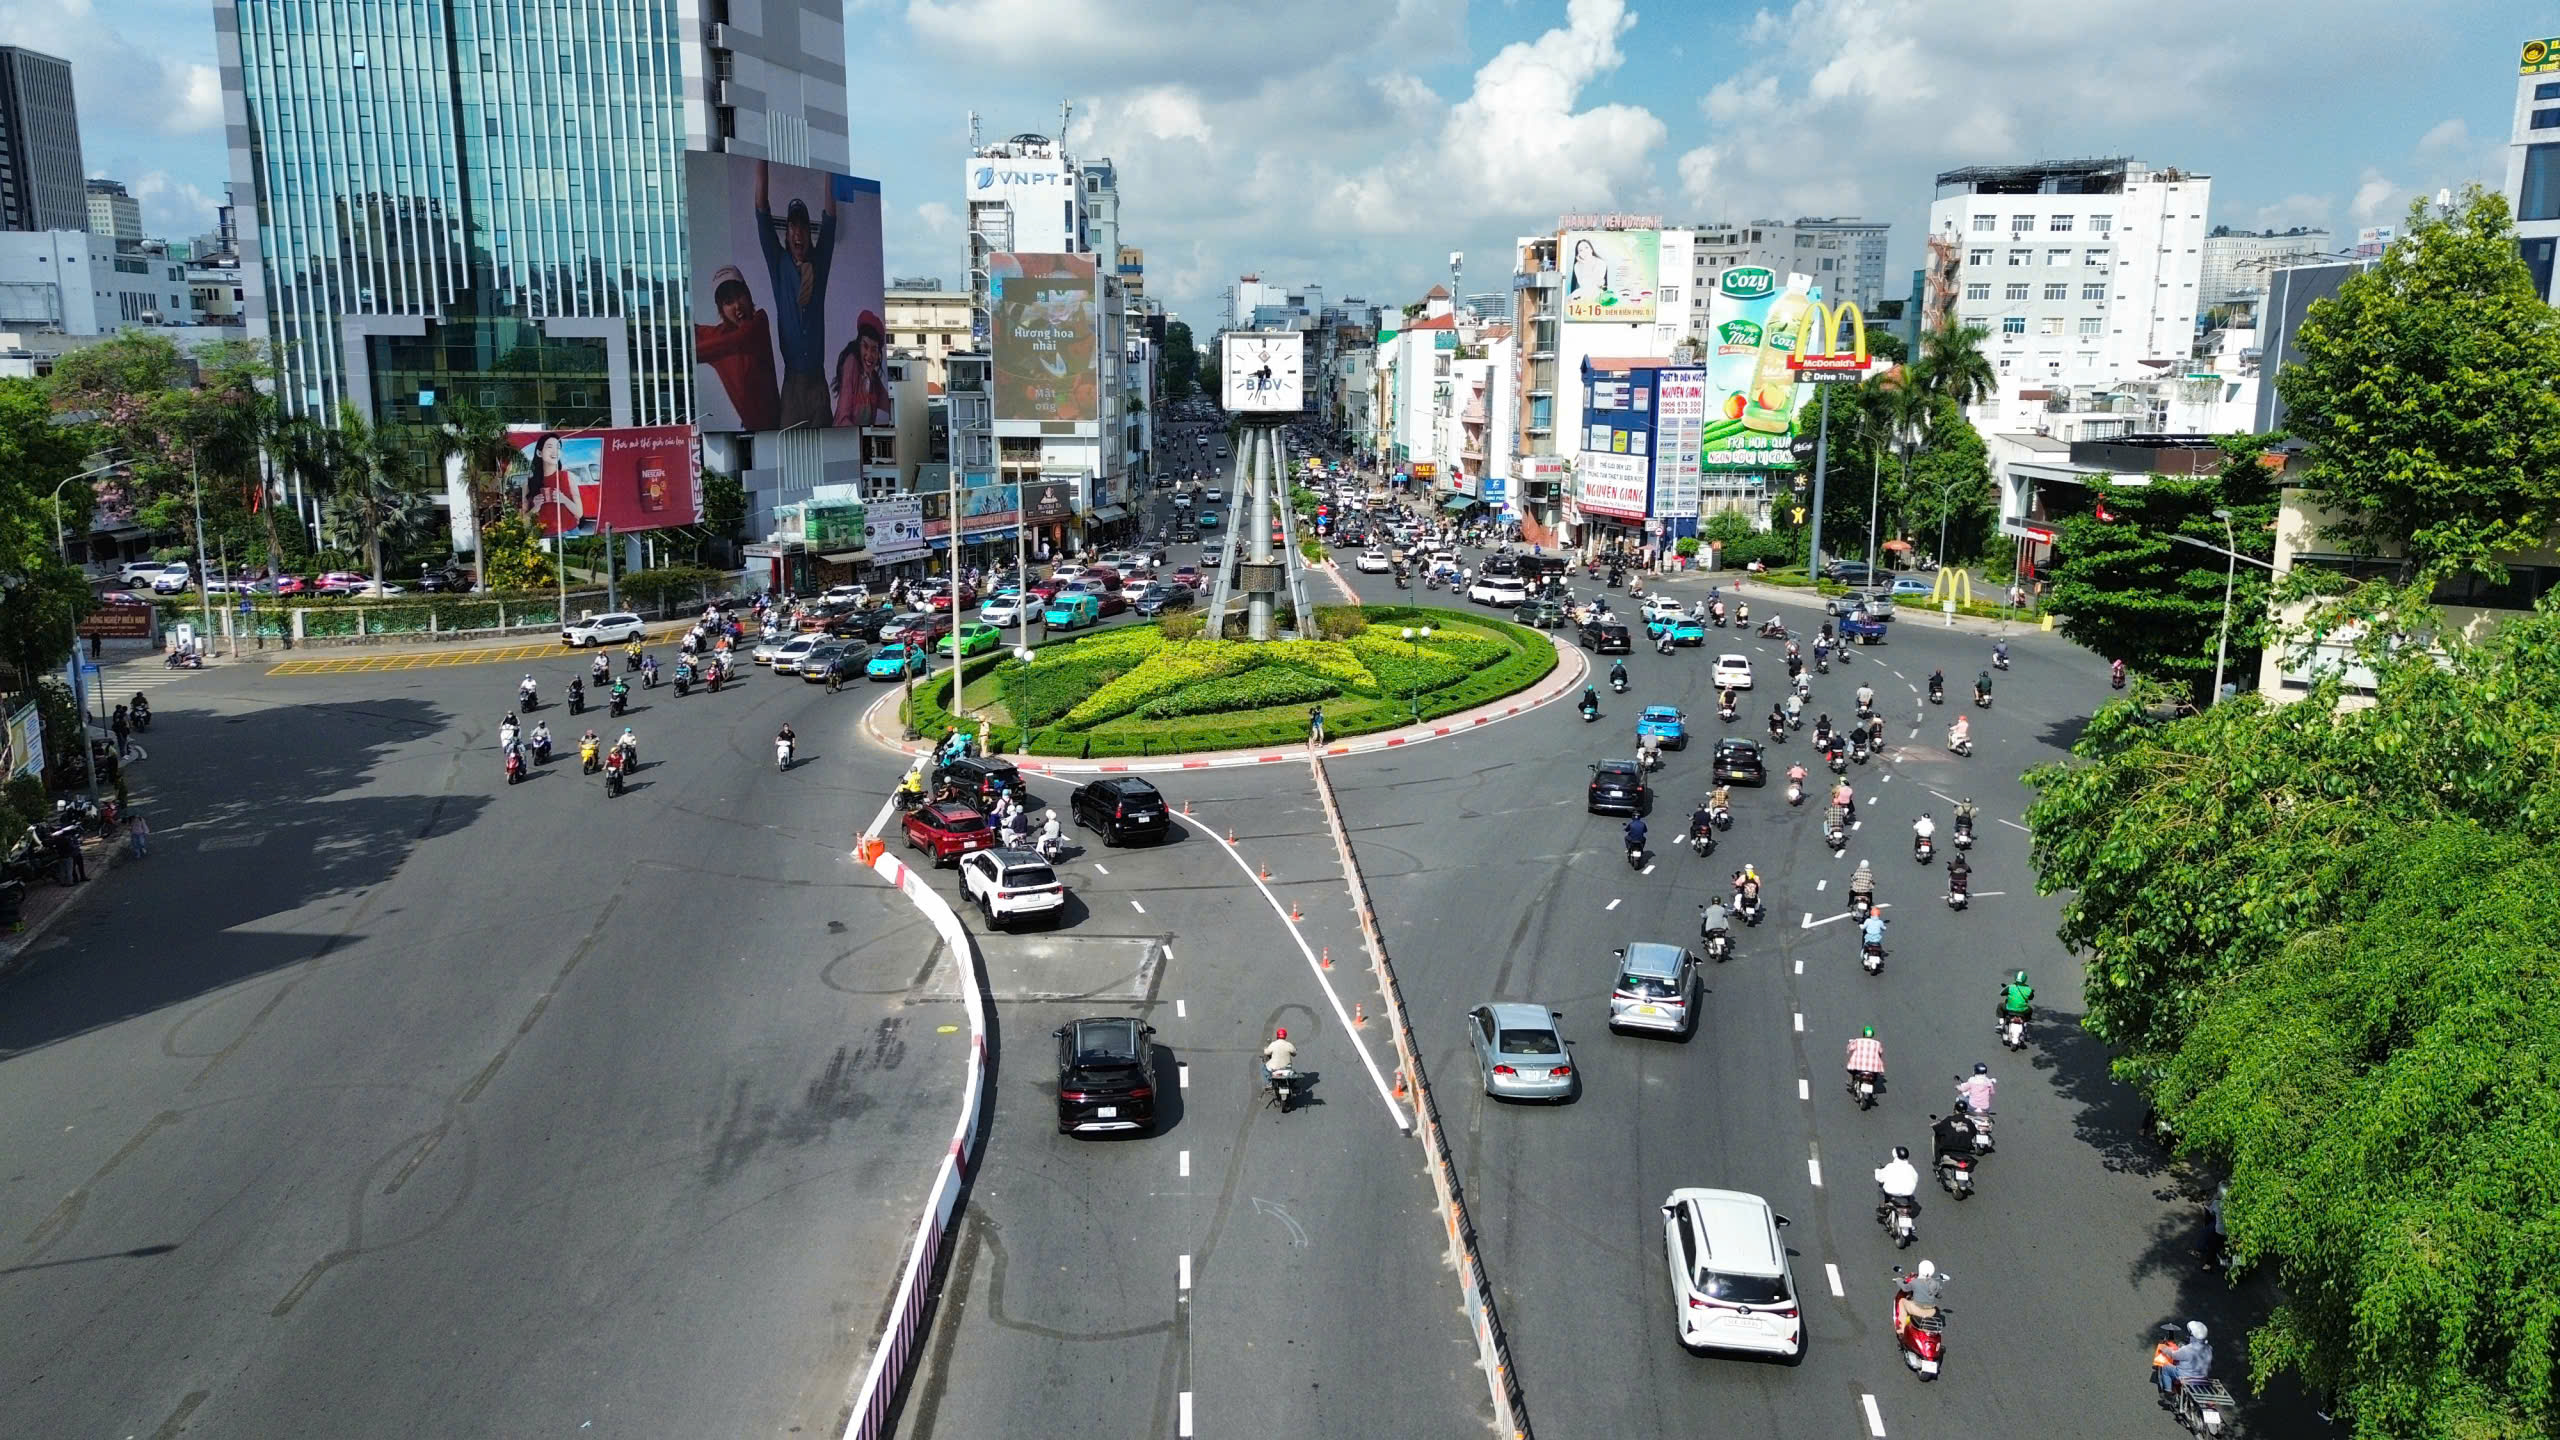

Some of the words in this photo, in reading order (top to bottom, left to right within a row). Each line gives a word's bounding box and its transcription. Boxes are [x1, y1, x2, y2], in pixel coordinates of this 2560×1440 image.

[1000, 171, 1058, 185] VNPT
[1726, 272, 1769, 291] Cozy
[1569, 305, 1602, 316] 14-16
[1015, 328, 1051, 339] Hương
[1055, 328, 1074, 338] hoa
[1803, 359, 1856, 368] McDonald's
[1813, 372, 1836, 380] Drive
[1838, 372, 1856, 380] Thru
[1619, 487, 1644, 503] GIANG
[911, 503, 921, 513] 7K
[907, 526, 920, 539] 7K
